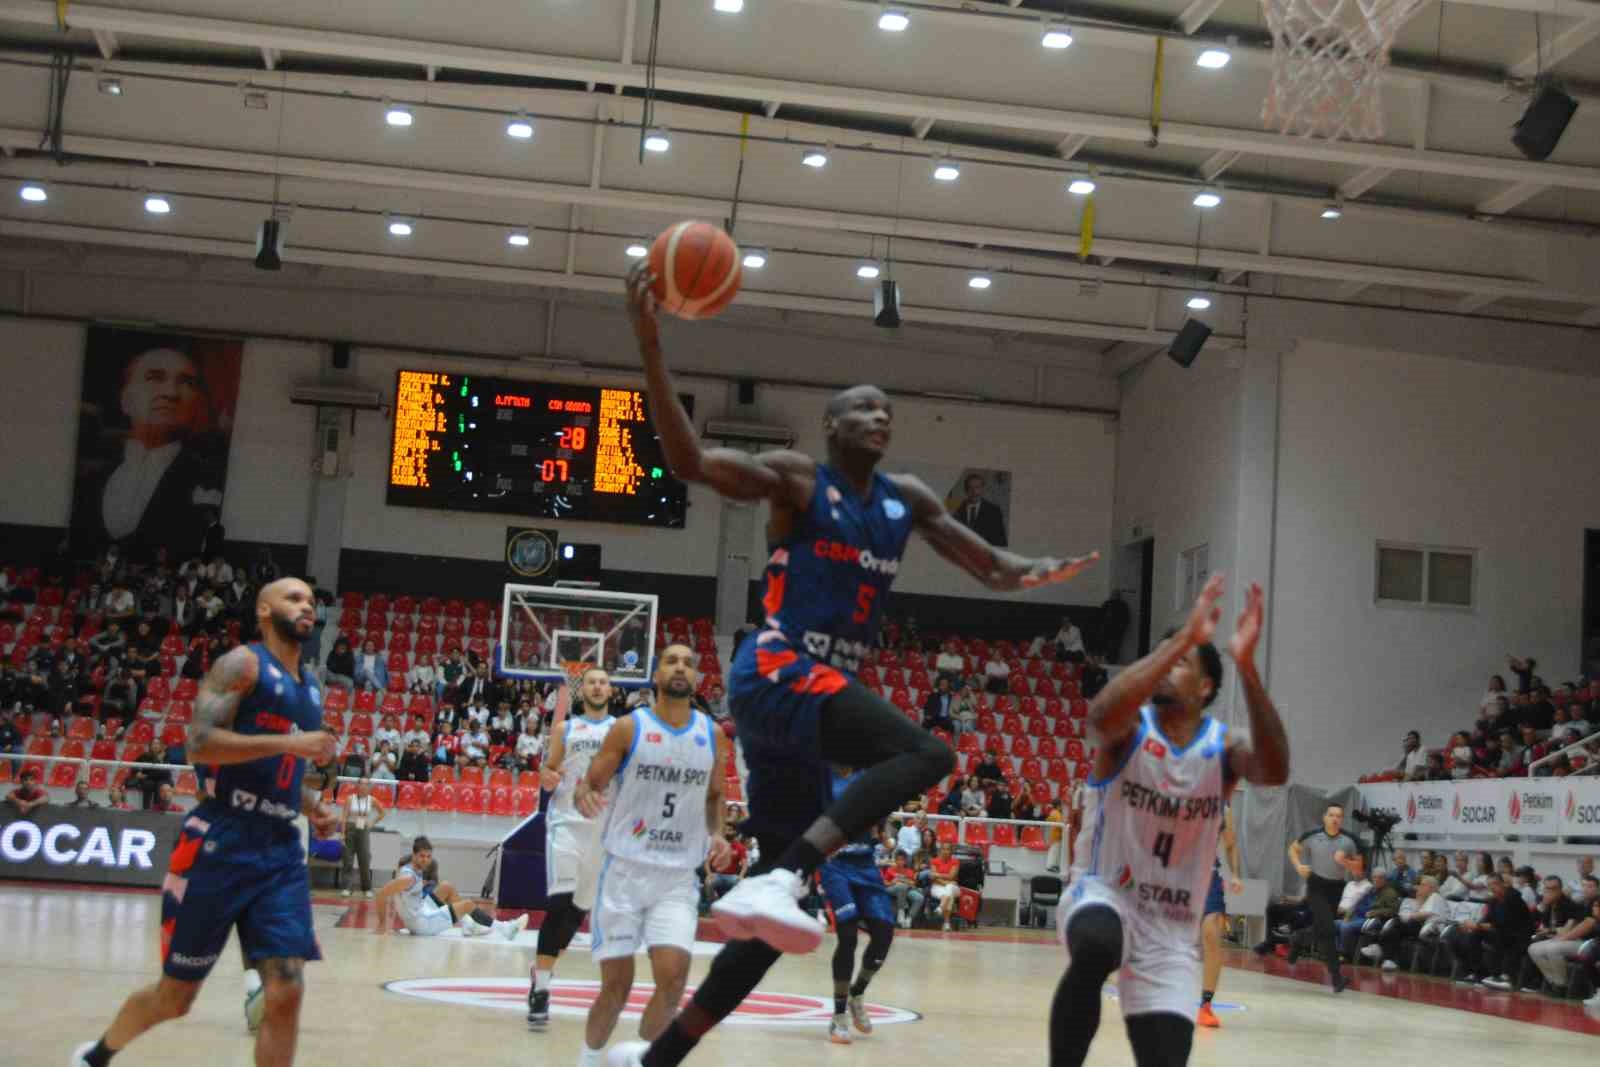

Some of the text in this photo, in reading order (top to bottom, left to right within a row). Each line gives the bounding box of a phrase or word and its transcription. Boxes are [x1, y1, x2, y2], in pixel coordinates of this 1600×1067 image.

[560, 427, 585, 450] 28
[542, 460, 568, 482] 07
[852, 584, 876, 624] 5
[662, 792, 677, 818] 5
[1462, 805, 1496, 824] SOCAR
[1578, 803, 1600, 825] SOC
[0, 820, 157, 868] OCAR
[648, 828, 683, 842] STAR
[1152, 831, 1175, 868] 4
[1139, 882, 1191, 907] STAR
